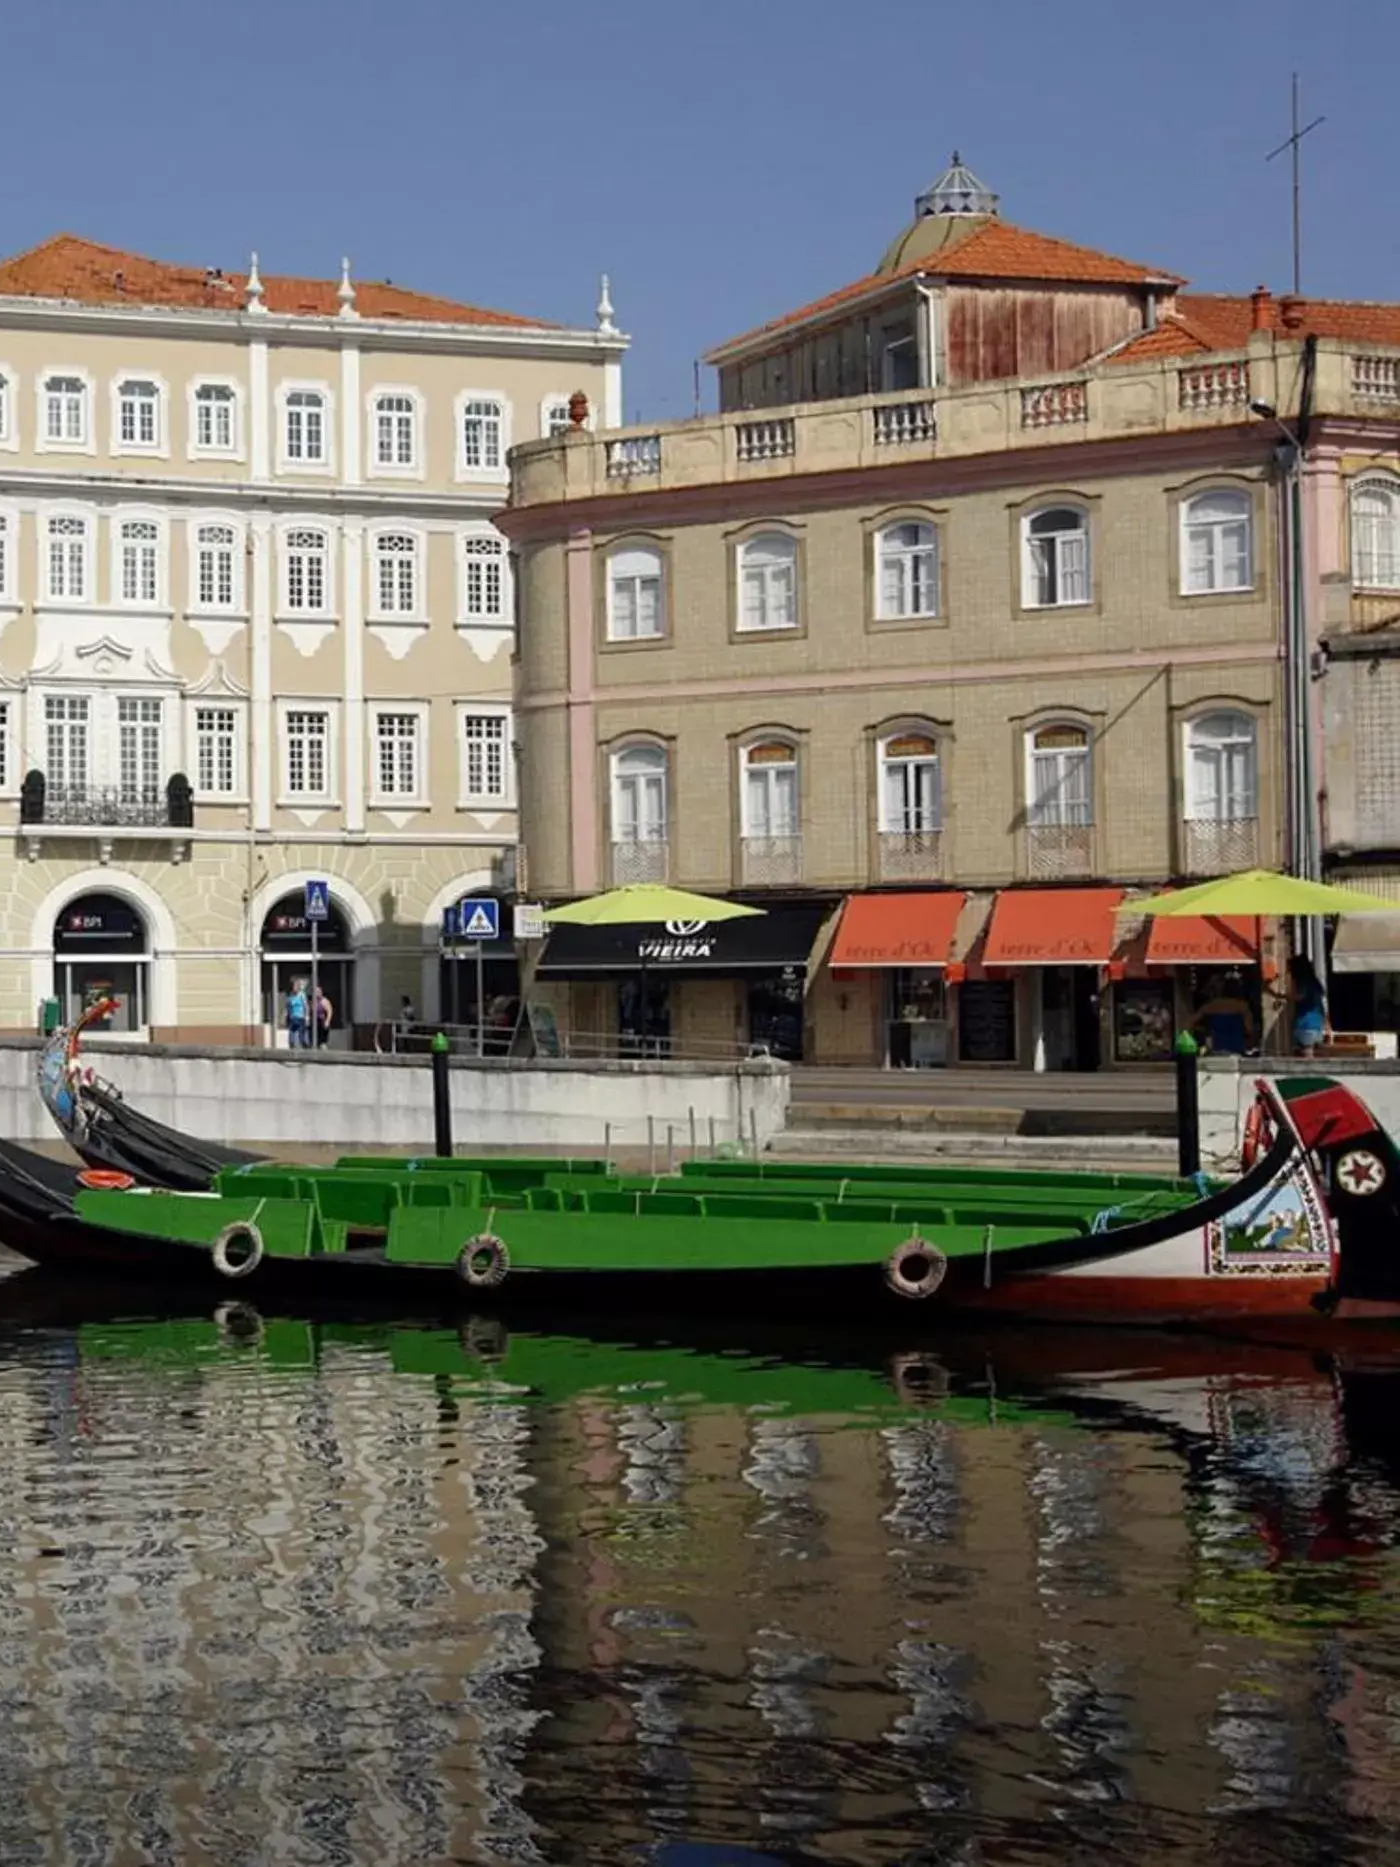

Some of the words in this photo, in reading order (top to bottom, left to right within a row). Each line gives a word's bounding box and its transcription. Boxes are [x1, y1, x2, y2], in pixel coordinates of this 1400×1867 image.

[83, 915, 102, 927] BPI
[288, 916, 306, 928] BPI
[638, 944, 711, 957] VIEIRA
